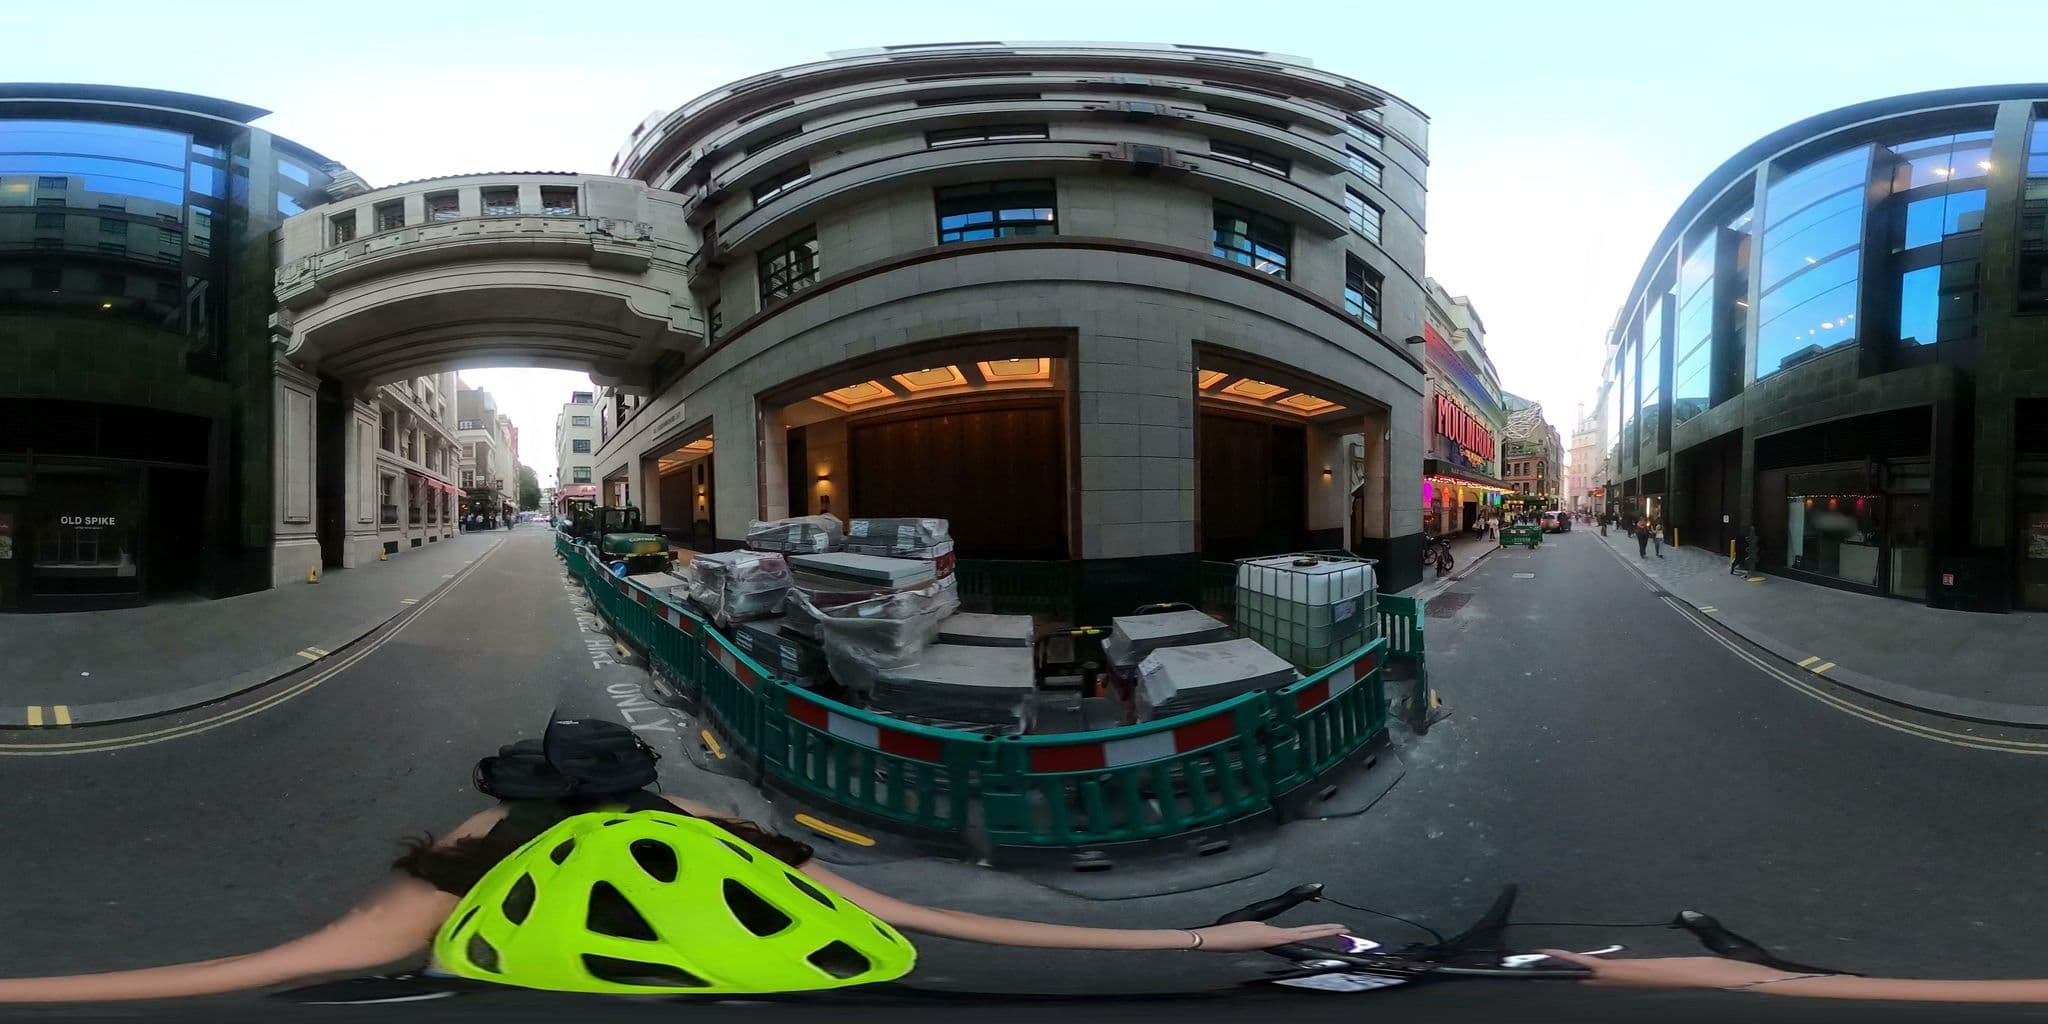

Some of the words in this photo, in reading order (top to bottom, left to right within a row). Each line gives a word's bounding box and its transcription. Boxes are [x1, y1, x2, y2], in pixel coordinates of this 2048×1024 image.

[60, 516, 82, 525] OLD
[85, 516, 116, 526] SPIKE
[584, 639, 616, 670] HIRE
[606, 683, 676, 732] ONLY
